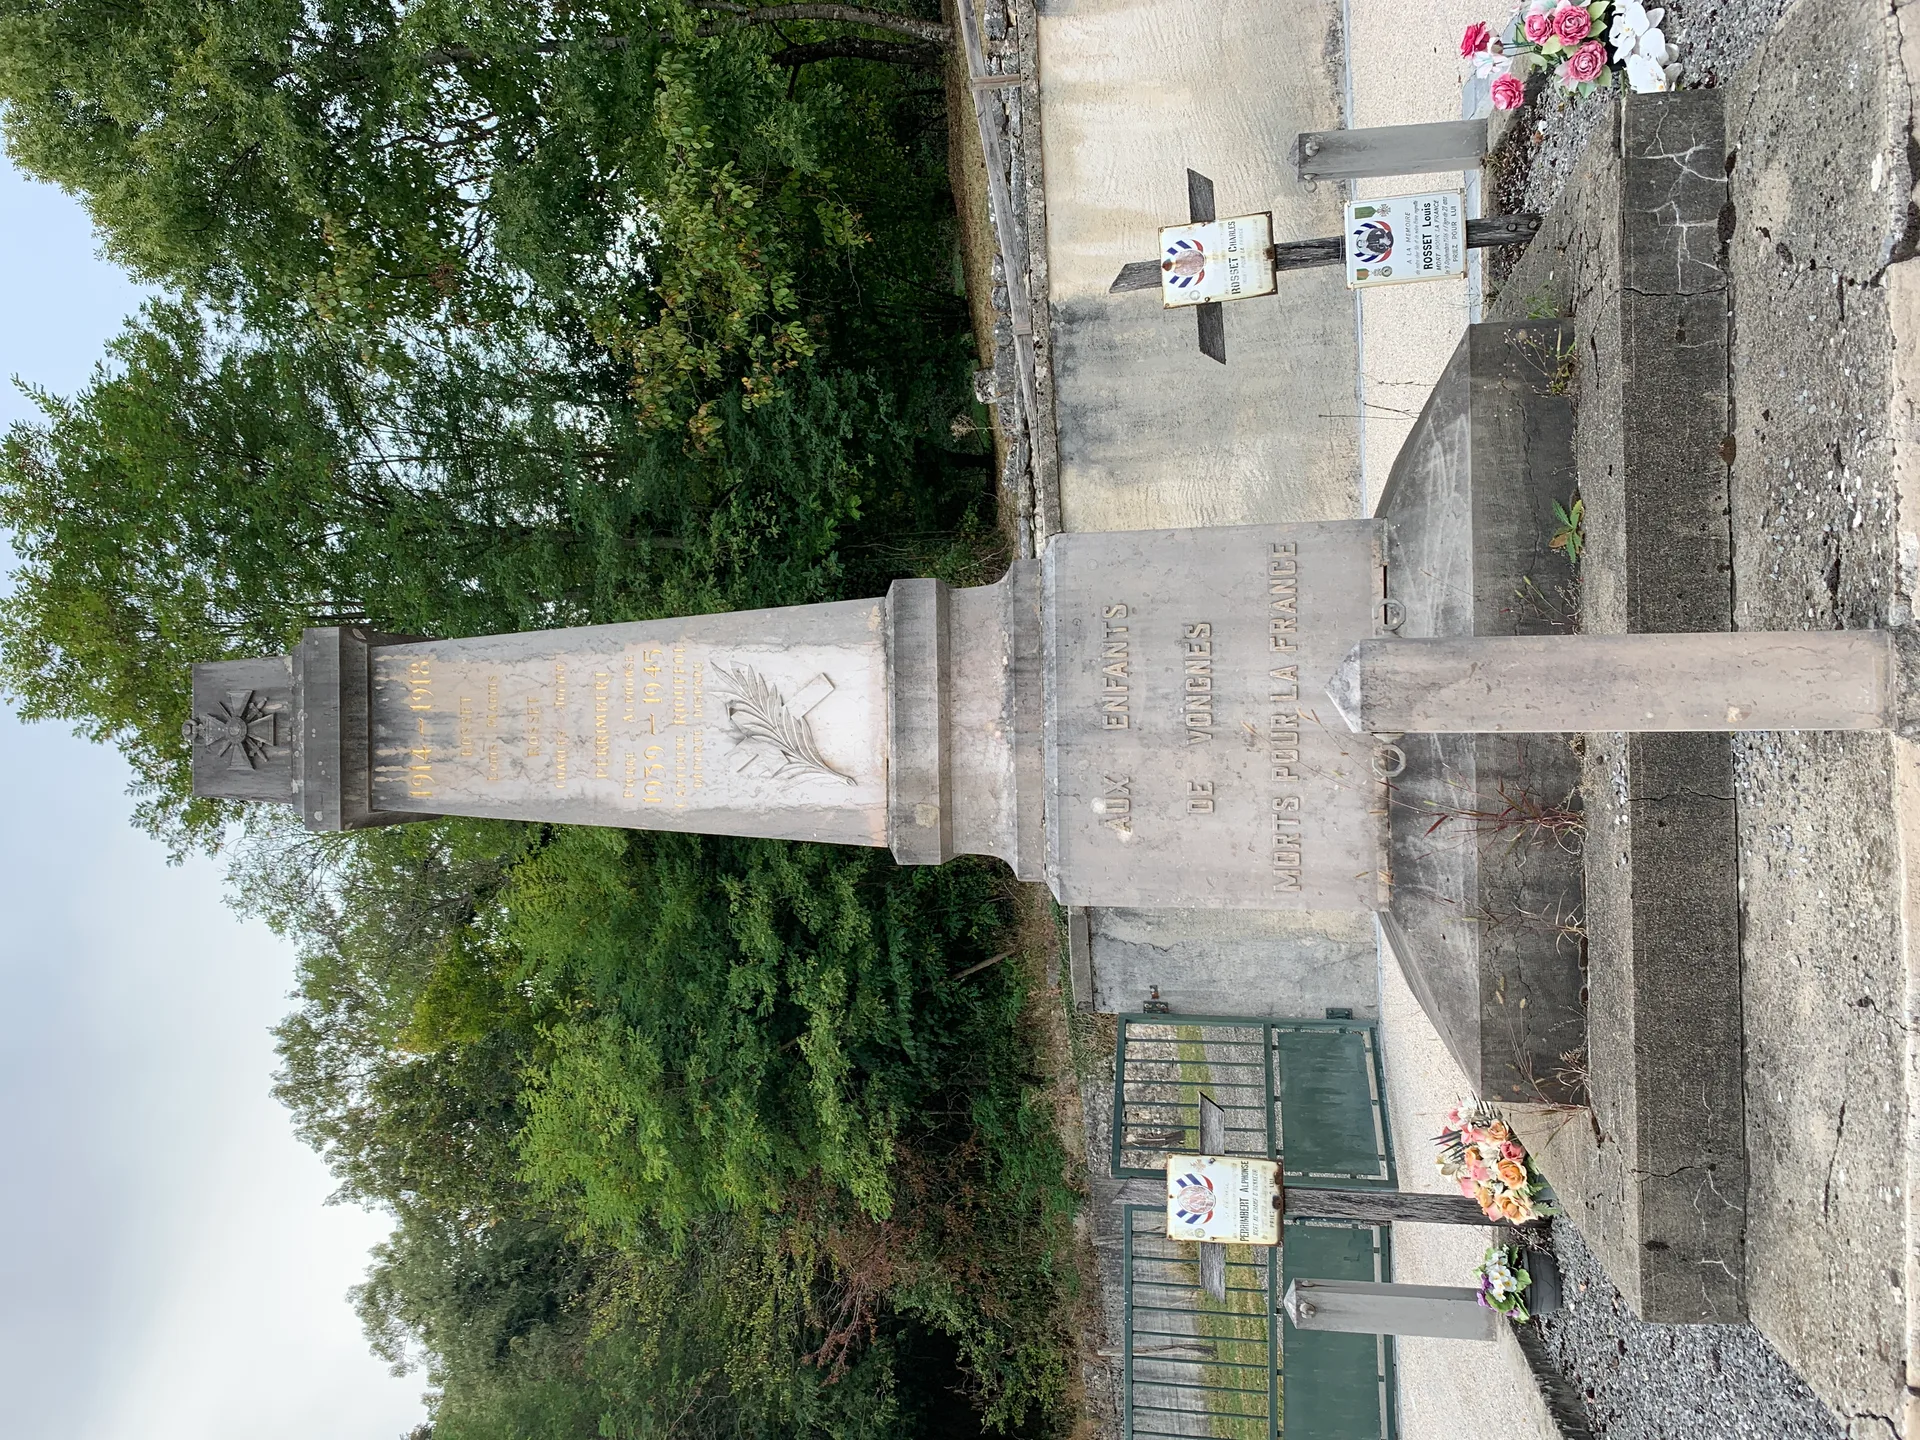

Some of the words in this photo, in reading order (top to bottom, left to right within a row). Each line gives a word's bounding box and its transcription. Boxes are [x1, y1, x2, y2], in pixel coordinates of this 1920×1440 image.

[1421, 203, 1431, 227] Louis
[1228, 257, 1241, 295] ROSSET
[1406, 247, 1412, 256] LA
[1422, 234, 1433, 270] ROSSET
[1268, 541, 1298, 653] FRANCE
[408, 660, 434, 712] 1918
[643, 649, 664, 704] 1945
[1101, 603, 1129, 730] ENFANTS
[1184, 622, 1213, 744] VONGNES
[1270, 665, 1298, 701] LA
[460, 695, 473, 756] ROSSET
[527, 695, 540, 757] ROSSET
[595, 671, 610, 779] PERRIMBERT
[1270, 713, 1299, 782] POUR
[409, 745, 435, 797] 1914
[643, 745, 667, 804] 1939
[1186, 781, 1214, 815] DE
[1102, 775, 1130, 832] AUX
[1271, 796, 1301, 892] MORTS
[1240, 1198, 1249, 1241] PERRIMBERT
